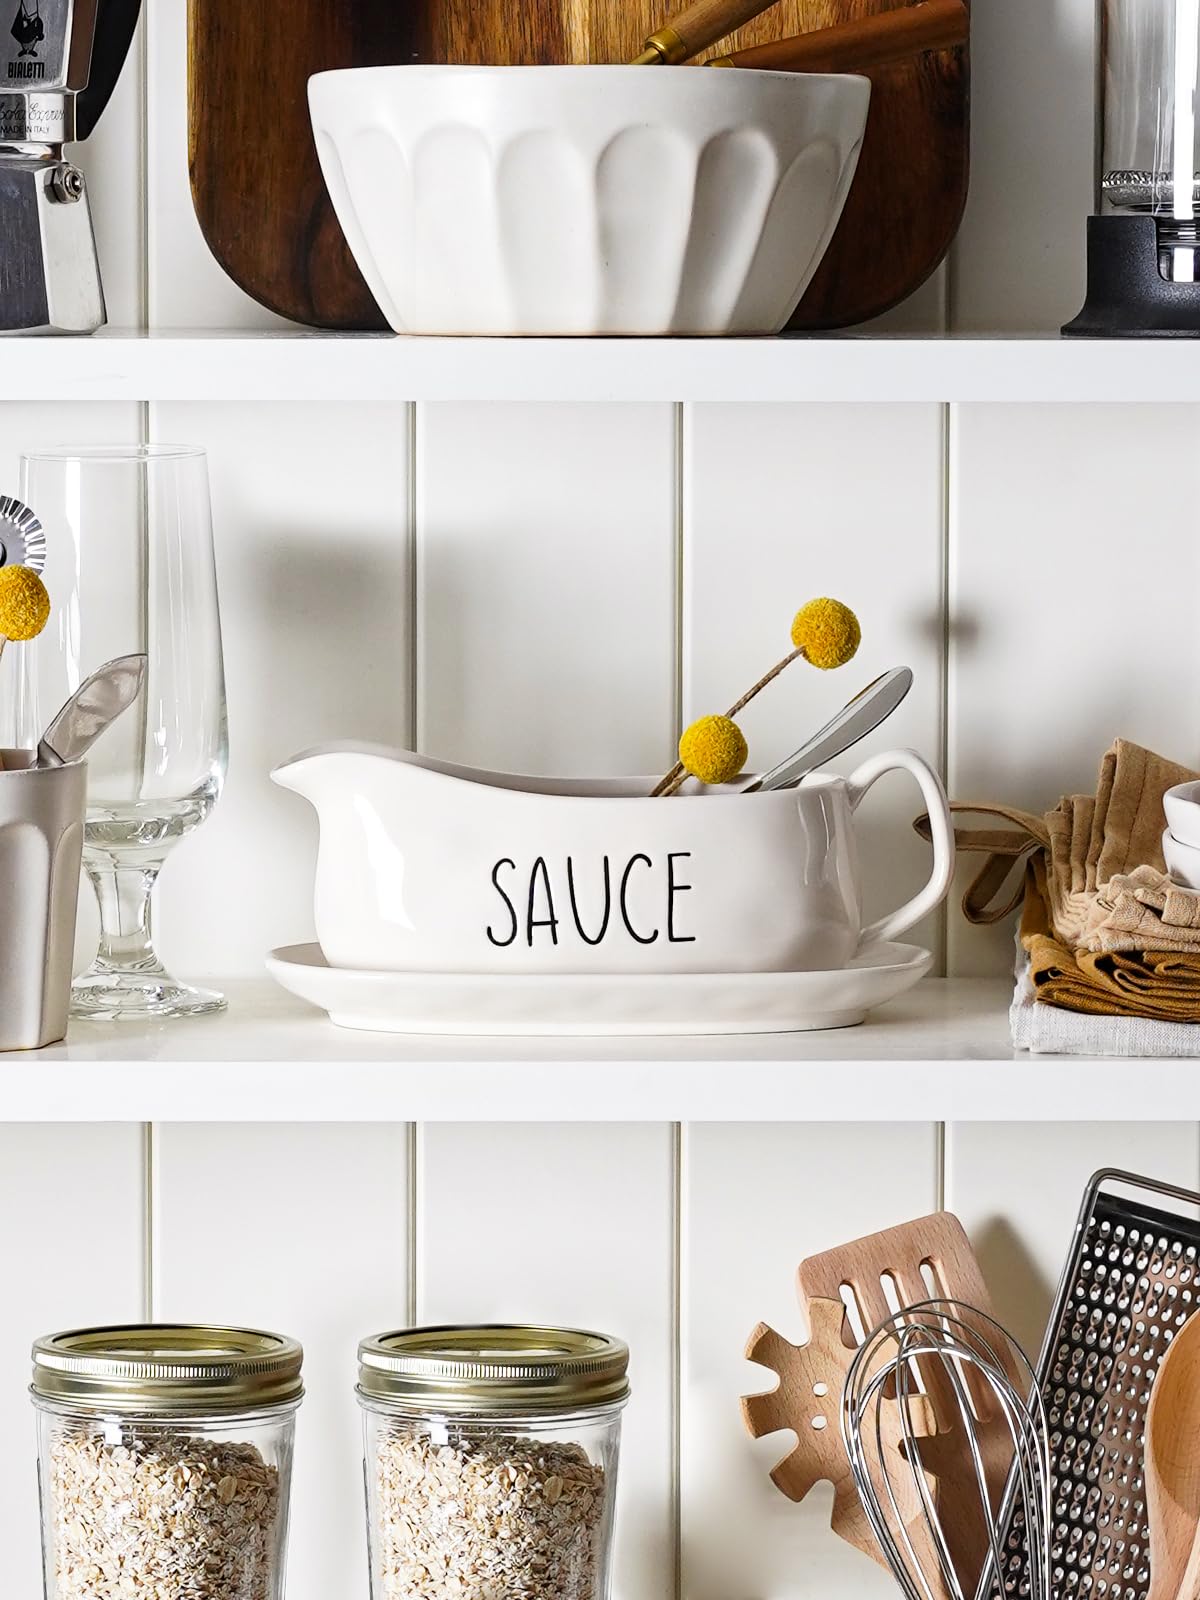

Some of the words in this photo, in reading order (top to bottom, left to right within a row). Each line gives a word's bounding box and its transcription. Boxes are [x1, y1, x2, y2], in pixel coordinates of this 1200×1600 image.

[0, 125, 24, 134] MADE
[33, 125, 50, 134] ITALY
[486, 852, 696, 947] SAUCE
